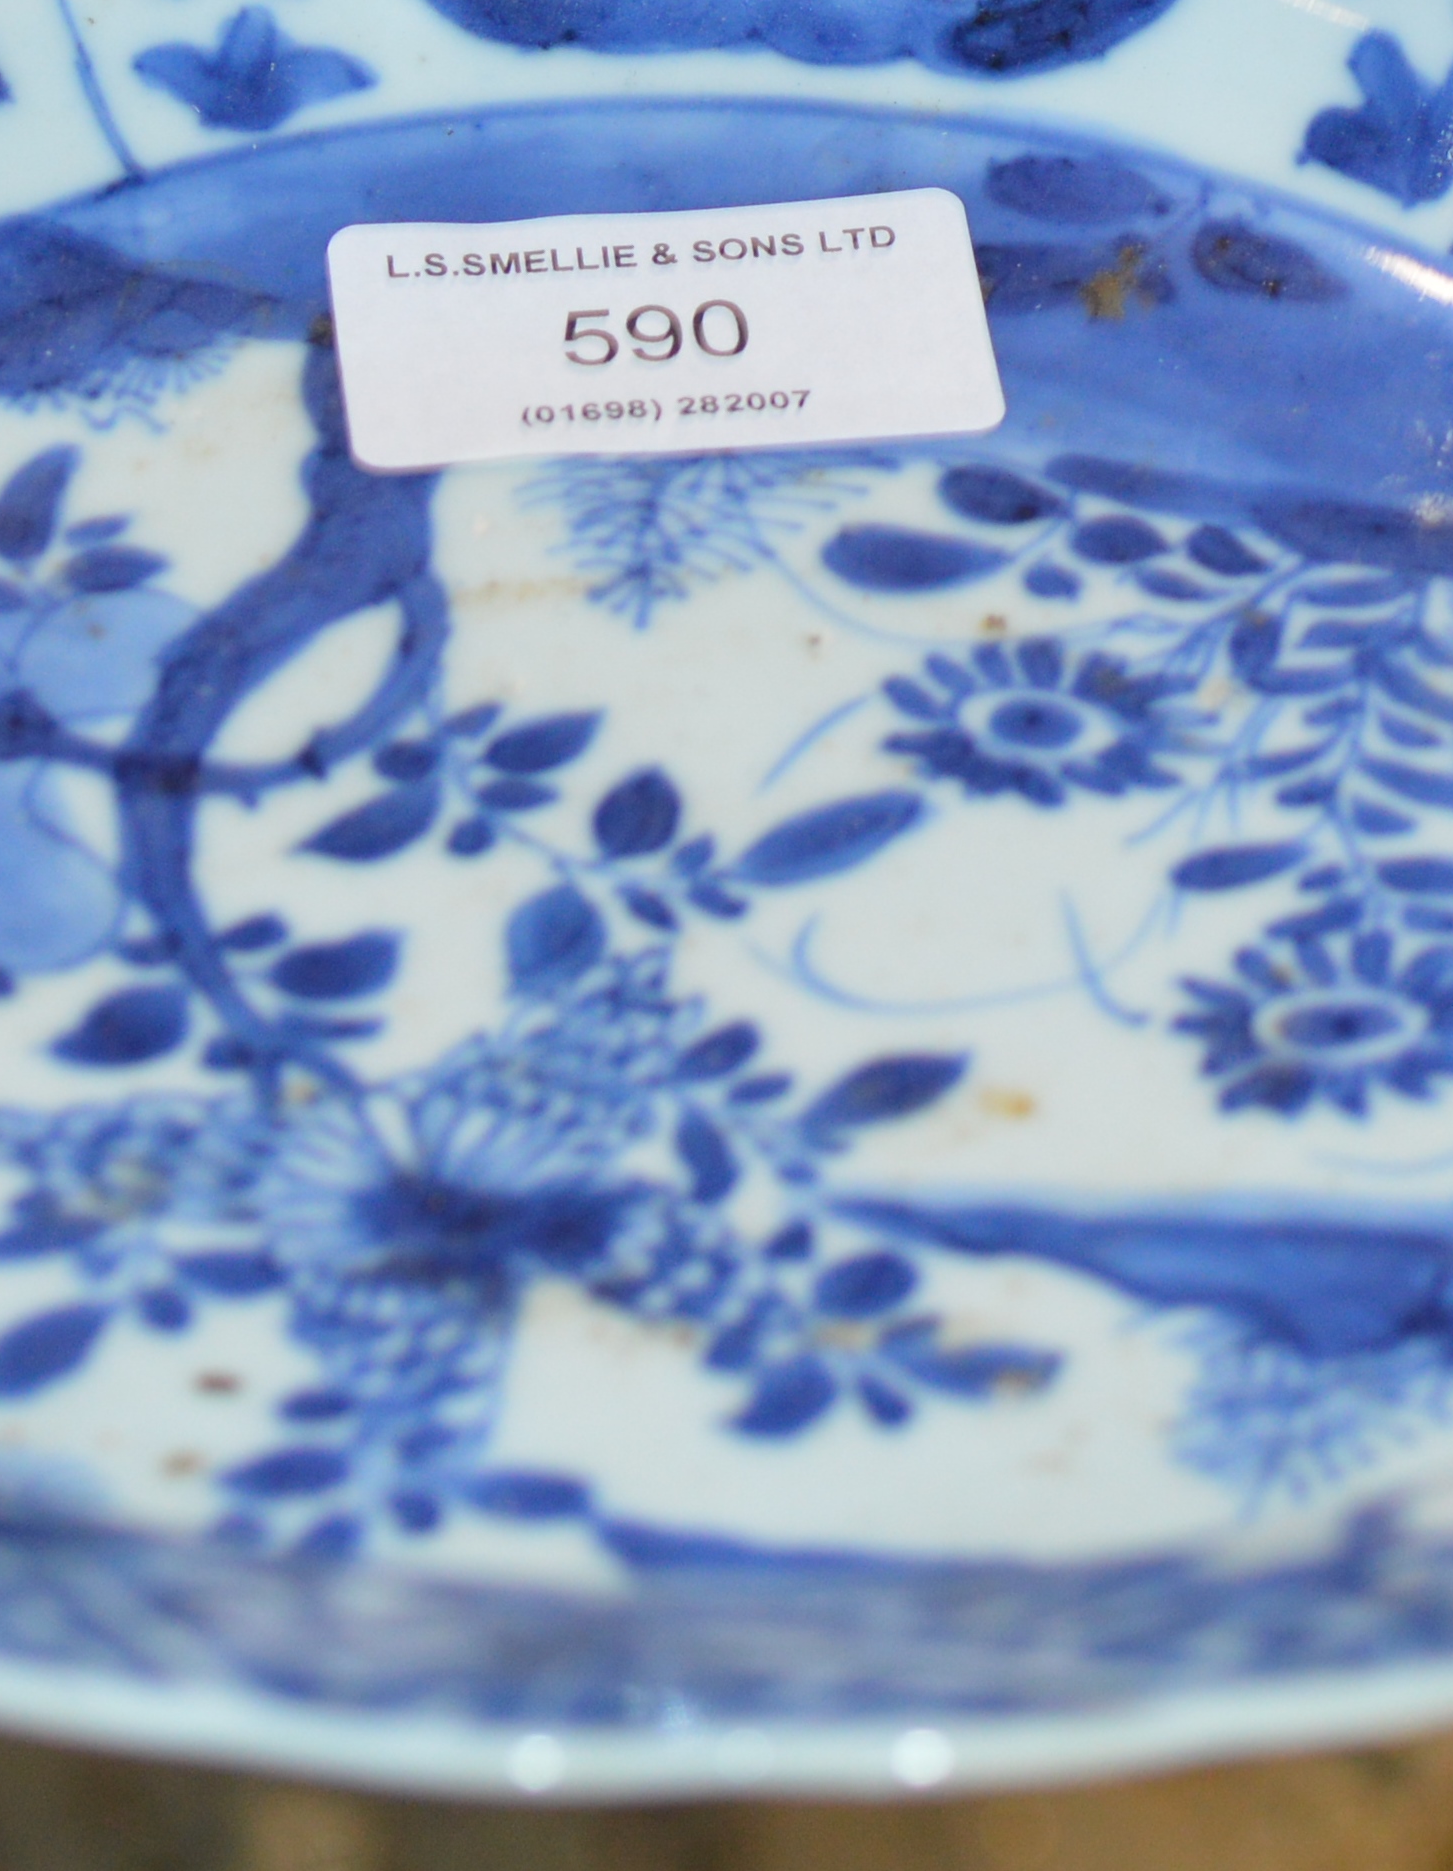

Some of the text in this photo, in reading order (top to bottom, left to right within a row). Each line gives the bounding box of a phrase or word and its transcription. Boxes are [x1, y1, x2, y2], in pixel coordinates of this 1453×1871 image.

[387, 224, 897, 278] L.S.SMELLIE & SONS LTD
[563, 299, 749, 366] 590
[522, 389, 812, 427] (01698) 282007
